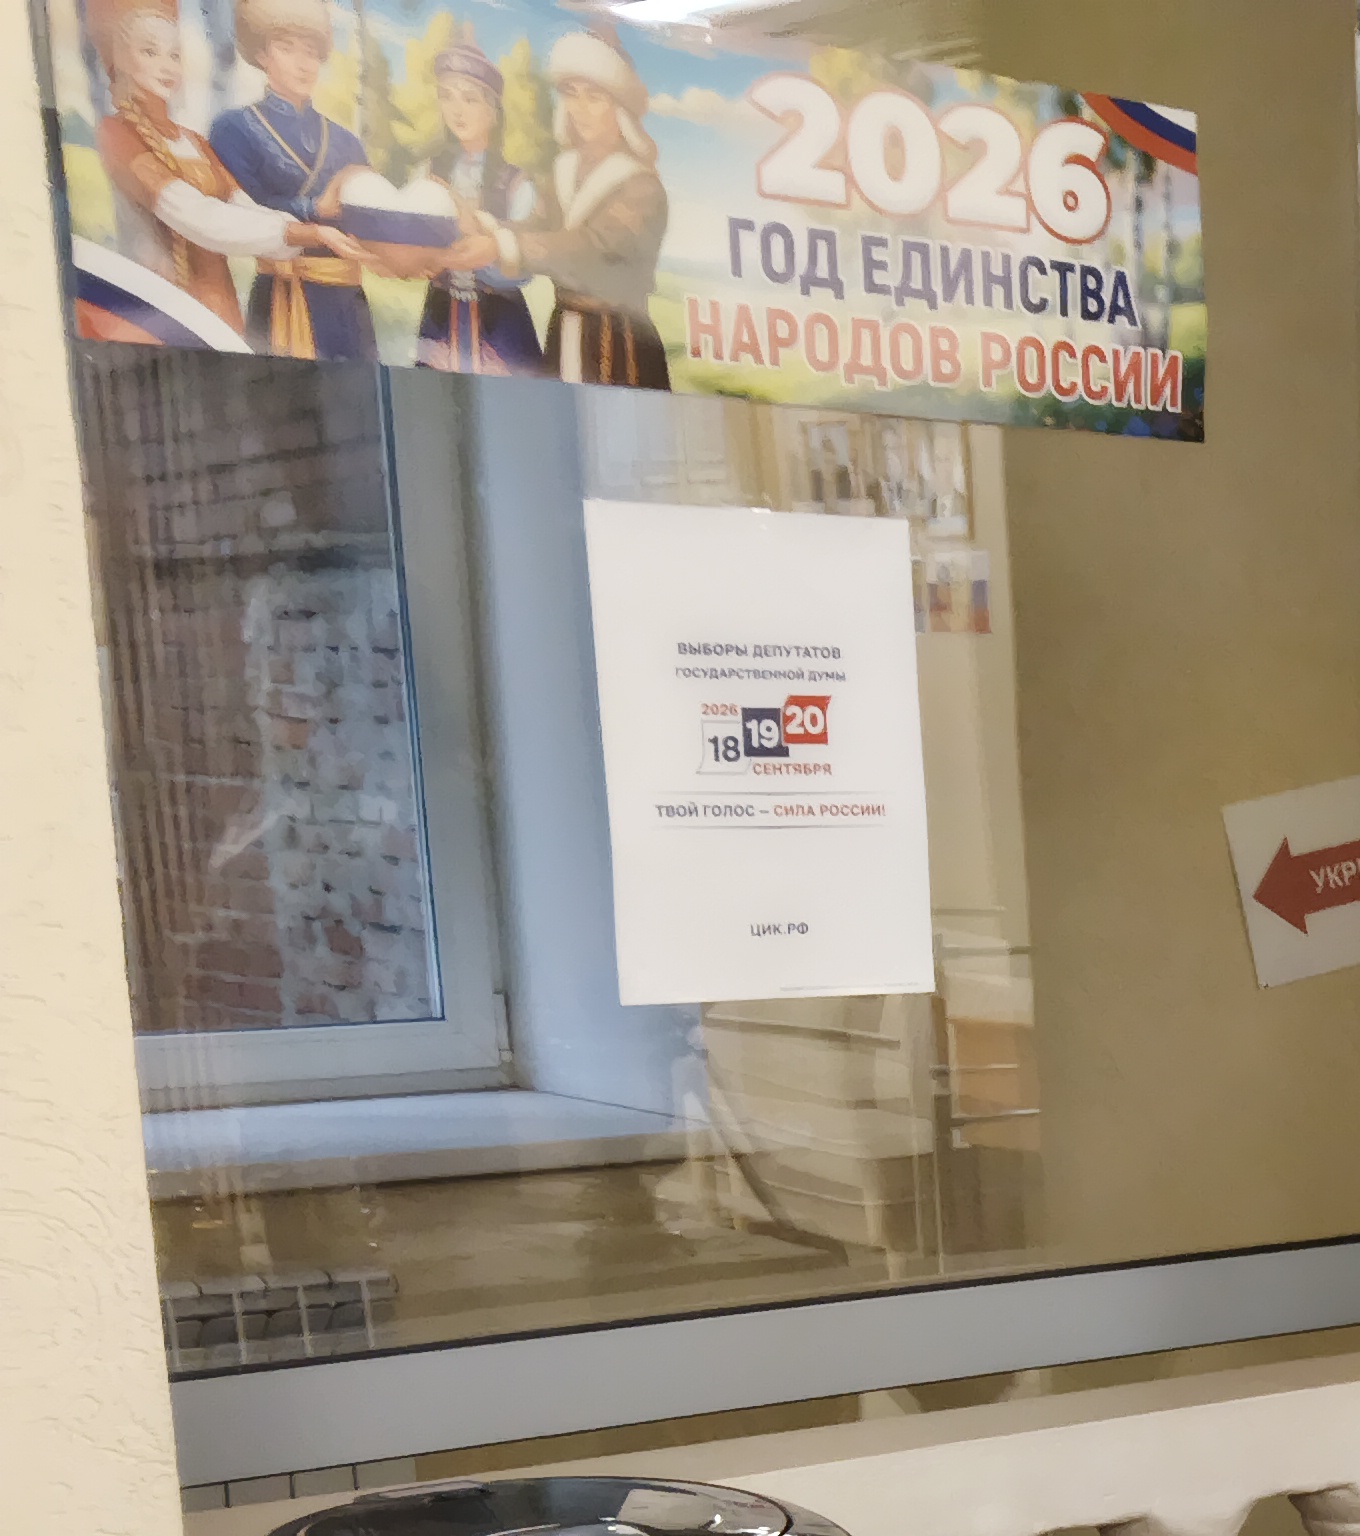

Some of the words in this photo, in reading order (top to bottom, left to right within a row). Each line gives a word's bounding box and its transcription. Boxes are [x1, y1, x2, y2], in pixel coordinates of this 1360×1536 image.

[749, 72, 1111, 245] 2026
[728, 217, 844, 300] ГОД
[861, 234, 1140, 328] ЕДИНСТВА
[686, 298, 962, 388] НАРОДОВ
[980, 331, 1182, 412] РОССИИ
[678, 642, 748, 658] ВЫБОРЫ
[752, 643, 841, 660] ДЕПУТАТОВ
[675, 667, 805, 682] ГОСУДАРСТВЕННОЙ
[808, 671, 846, 683] ДУМЫ
[701, 703, 739, 716] 2026
[708, 735, 741, 763] 18
[747, 719, 779, 748] 19
[786, 705, 825, 734] 20
[752, 762, 832, 776] СЕНТЯБРЯ
[656, 802, 699, 819] ТВОЙ
[704, 804, 755, 818] ГОЛОС
[774, 803, 815, 818] СИЛА
[819, 803, 886, 818] РОССИИ!
[751, 921, 809, 938] ЦИК.РФ
